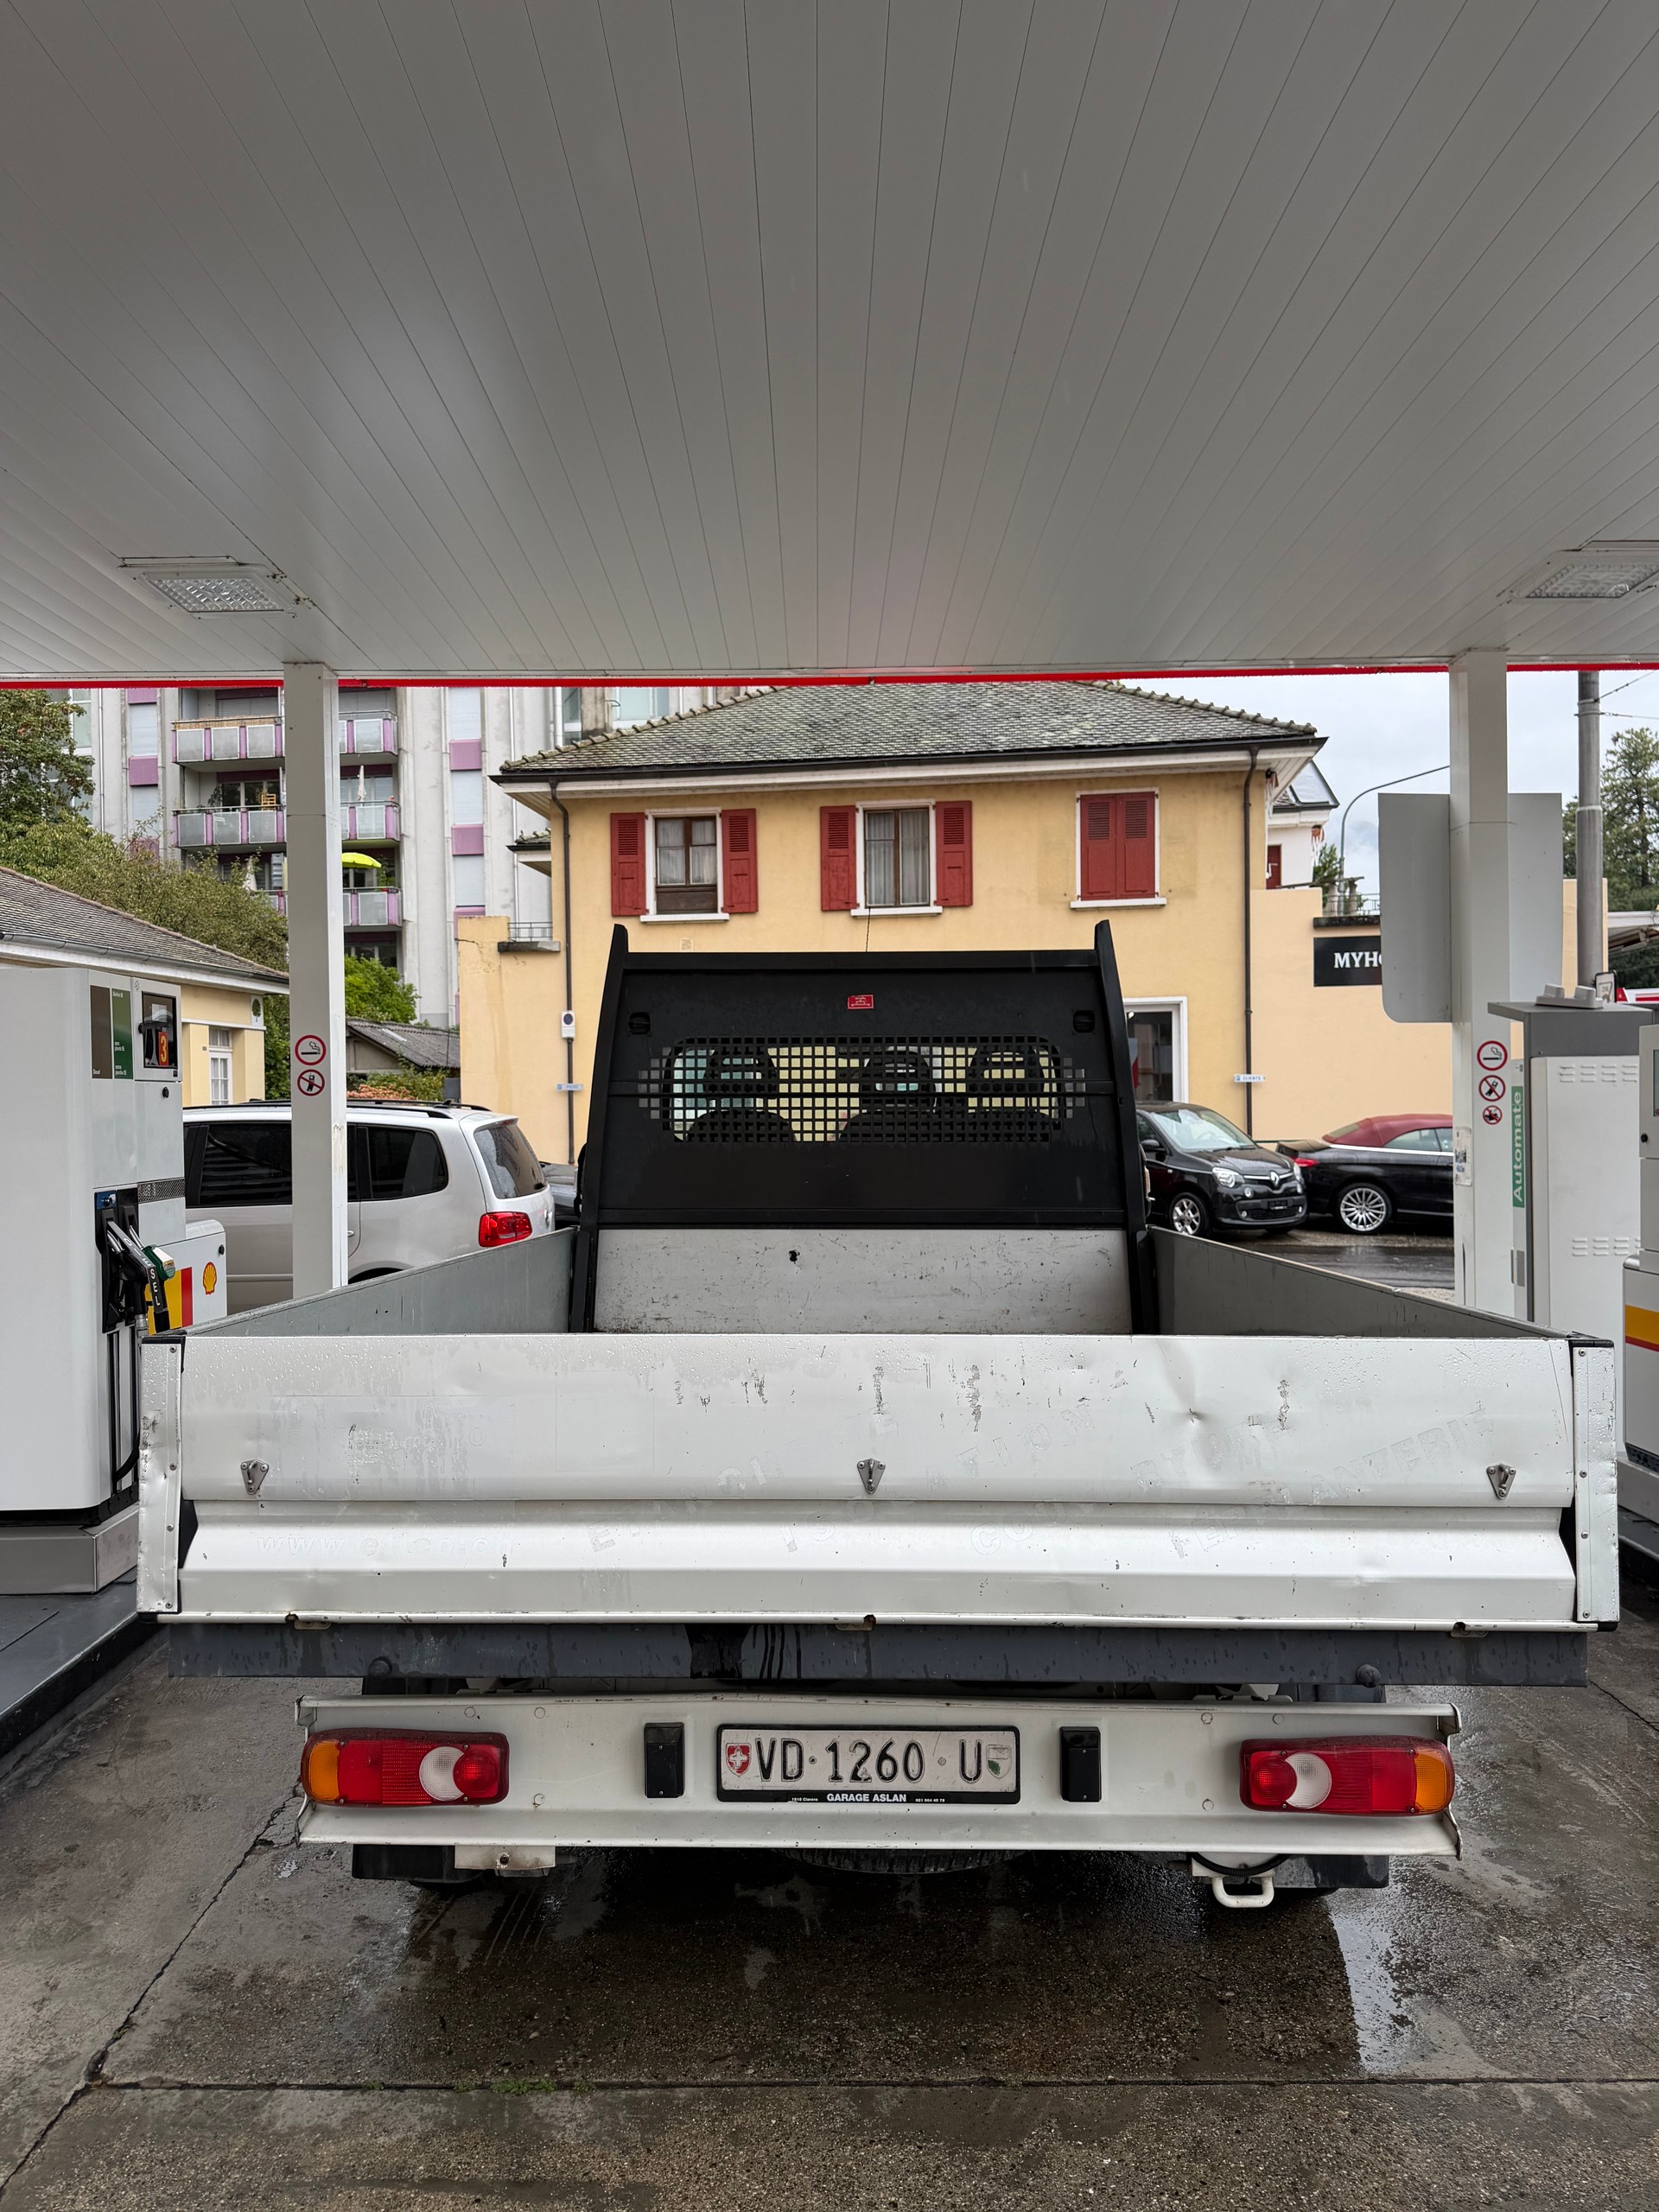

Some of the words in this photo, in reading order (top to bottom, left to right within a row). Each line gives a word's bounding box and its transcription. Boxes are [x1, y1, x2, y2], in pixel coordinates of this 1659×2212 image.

[160, 1035, 168, 1063] 3
[1514, 1091, 1522, 1202] Automate
[754, 1737, 804, 1782] VD
[824, 1738, 926, 1783] 1260
[958, 1738, 983, 1783] U
[826, 1793, 870, 1802] GARAGE
[872, 1793, 907, 1803] ASLAN
